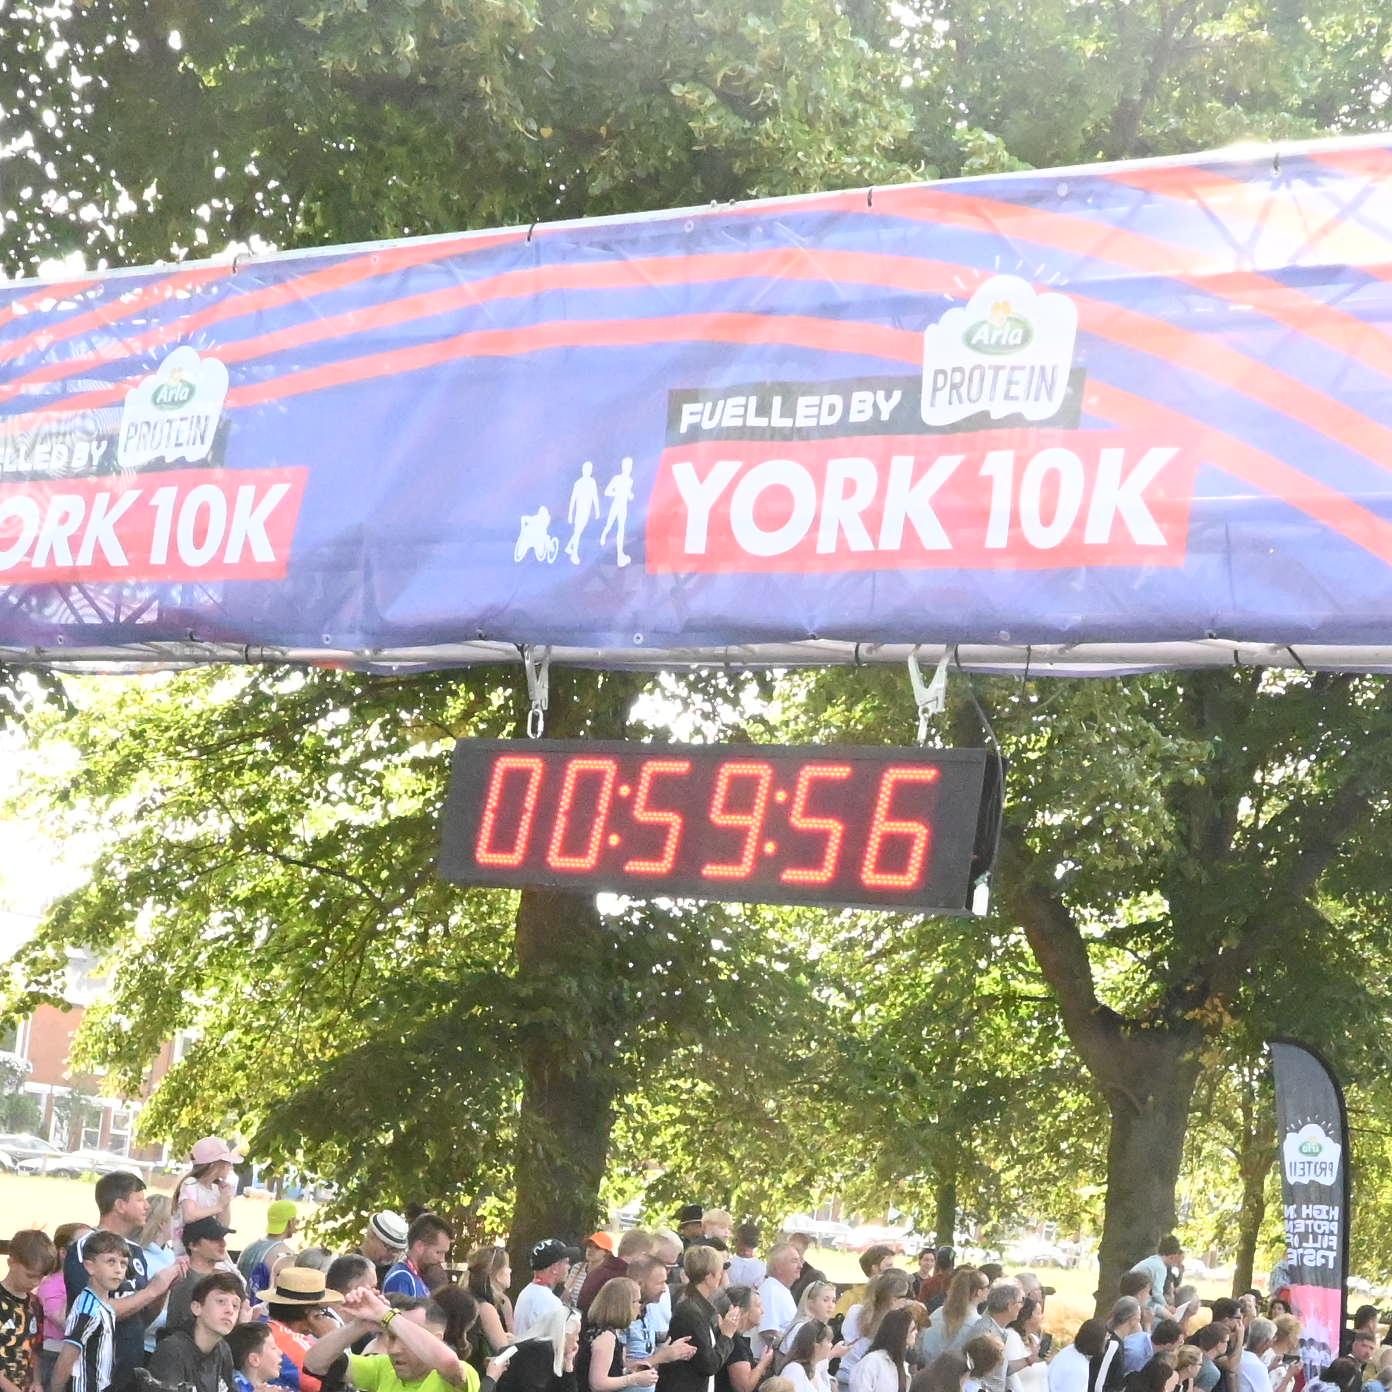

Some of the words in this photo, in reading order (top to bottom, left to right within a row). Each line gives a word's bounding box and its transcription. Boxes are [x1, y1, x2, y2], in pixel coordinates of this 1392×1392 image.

[971, 322, 1024, 346] Arla
[156, 385, 190, 404] Arla
[930, 363, 1059, 408] PROTEIN
[124, 414, 210, 454] PROTEIN
[679, 395, 844, 434] FUELLED
[849, 390, 902, 425] BY
[72, 439, 108, 472] BY
[149, 482, 293, 566] 10K
[671, 453, 964, 558] YORK
[980, 446, 1181, 550] 10K
[475, 756, 940, 889] 00:59:56
